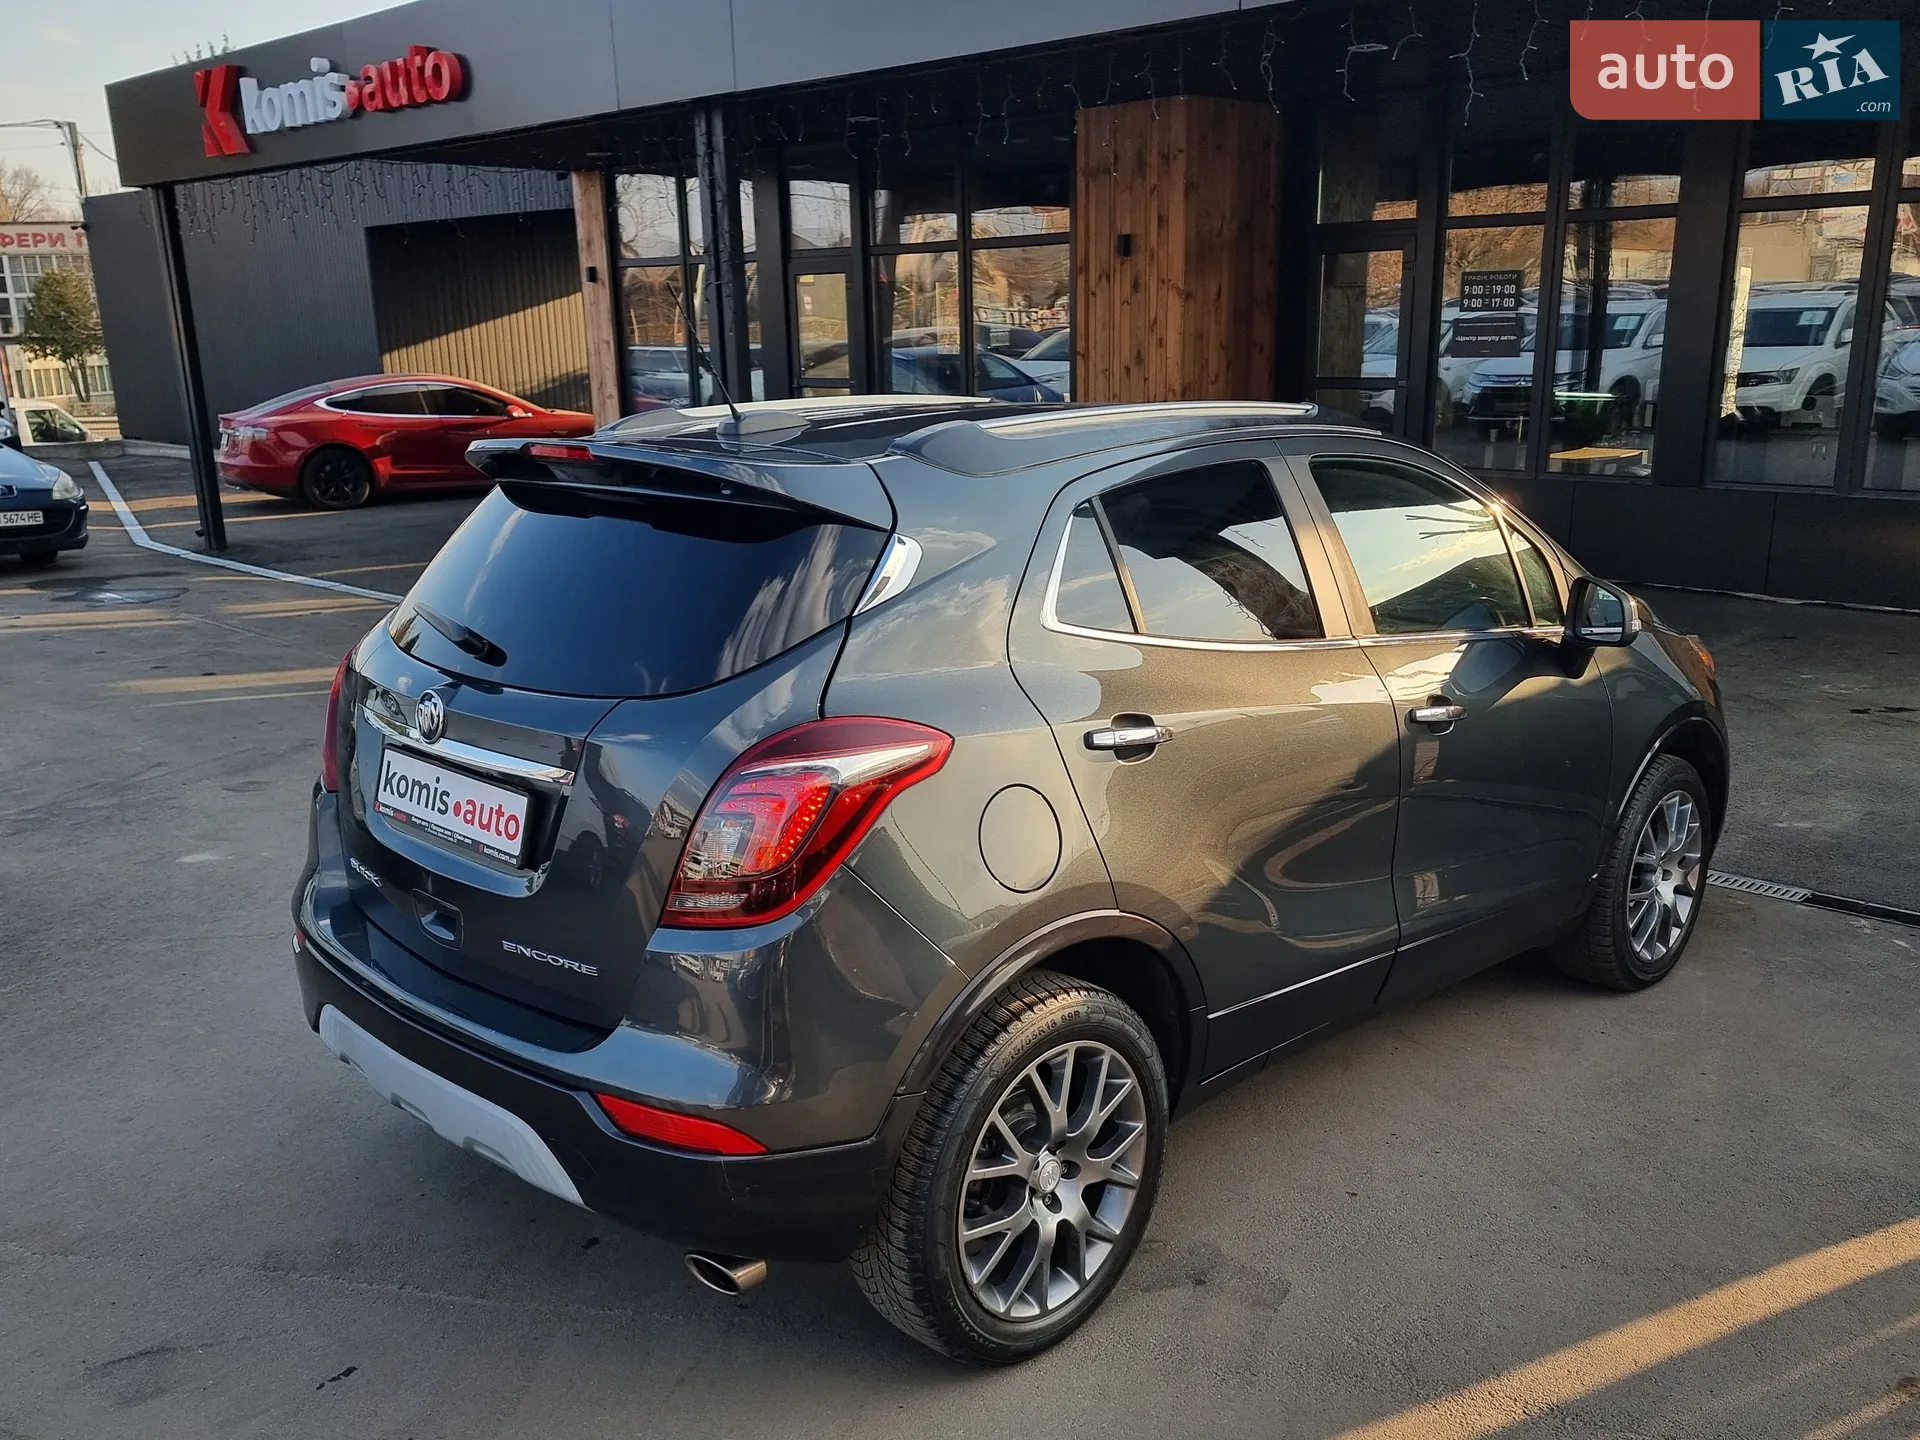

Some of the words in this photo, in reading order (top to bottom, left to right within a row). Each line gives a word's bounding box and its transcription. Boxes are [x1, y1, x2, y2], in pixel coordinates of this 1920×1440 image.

[1464, 285, 1483, 294] 9:00
[1492, 285, 1516, 294] 19:00
[1463, 298, 1482, 307] 9:00
[1491, 298, 1515, 307] 17:00
[501, 940, 599, 976] ENCORE
